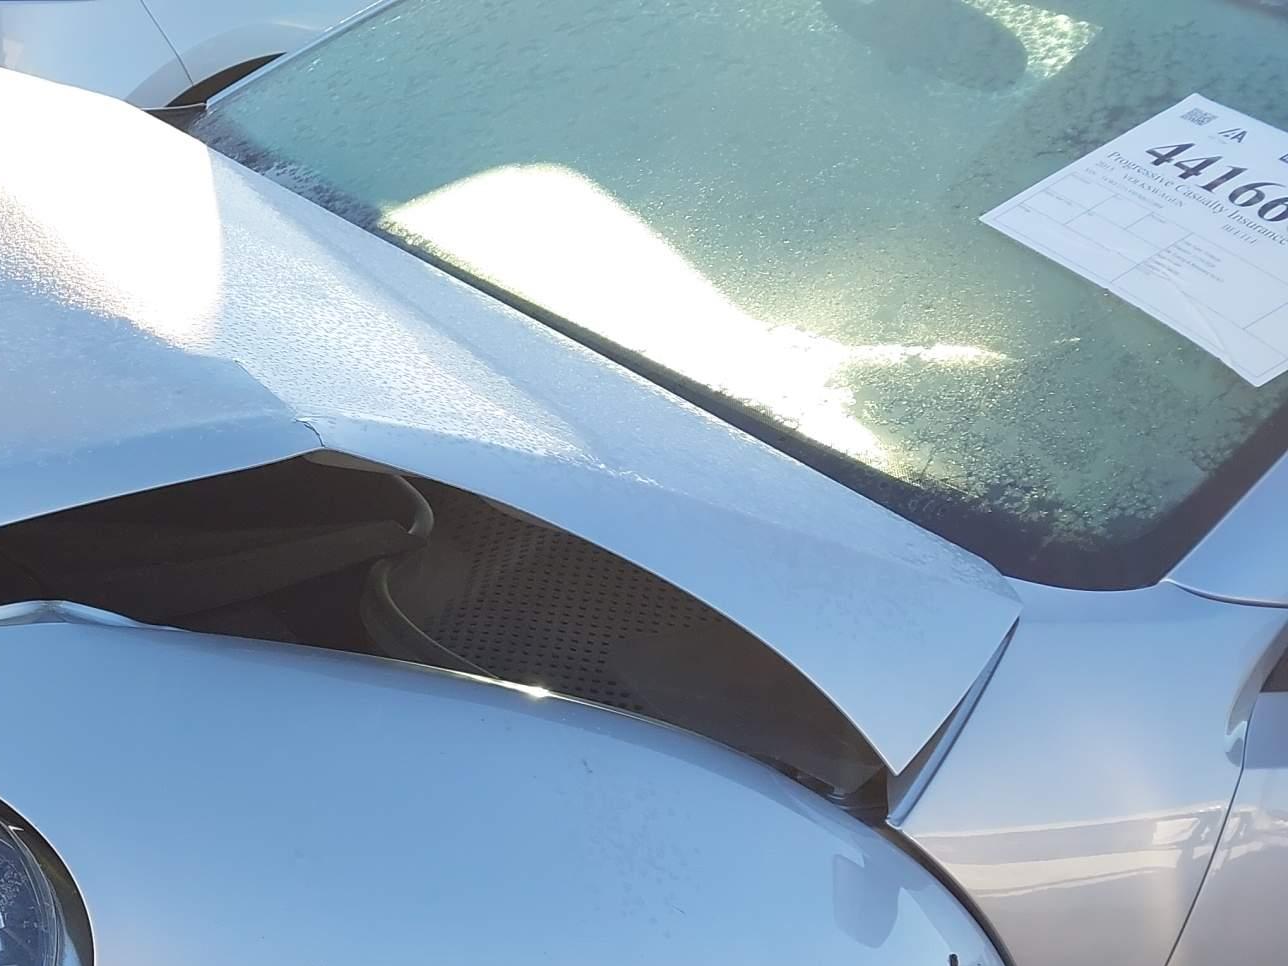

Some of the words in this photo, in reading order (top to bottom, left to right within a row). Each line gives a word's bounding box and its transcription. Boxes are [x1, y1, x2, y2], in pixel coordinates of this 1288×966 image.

[1107, 151, 1174, 187] Progressive
[1175, 183, 1226, 215] Casualty
[1227, 209, 1288, 246] Insurance
[1122, 173, 1184, 208] VOLKSWAGEN
